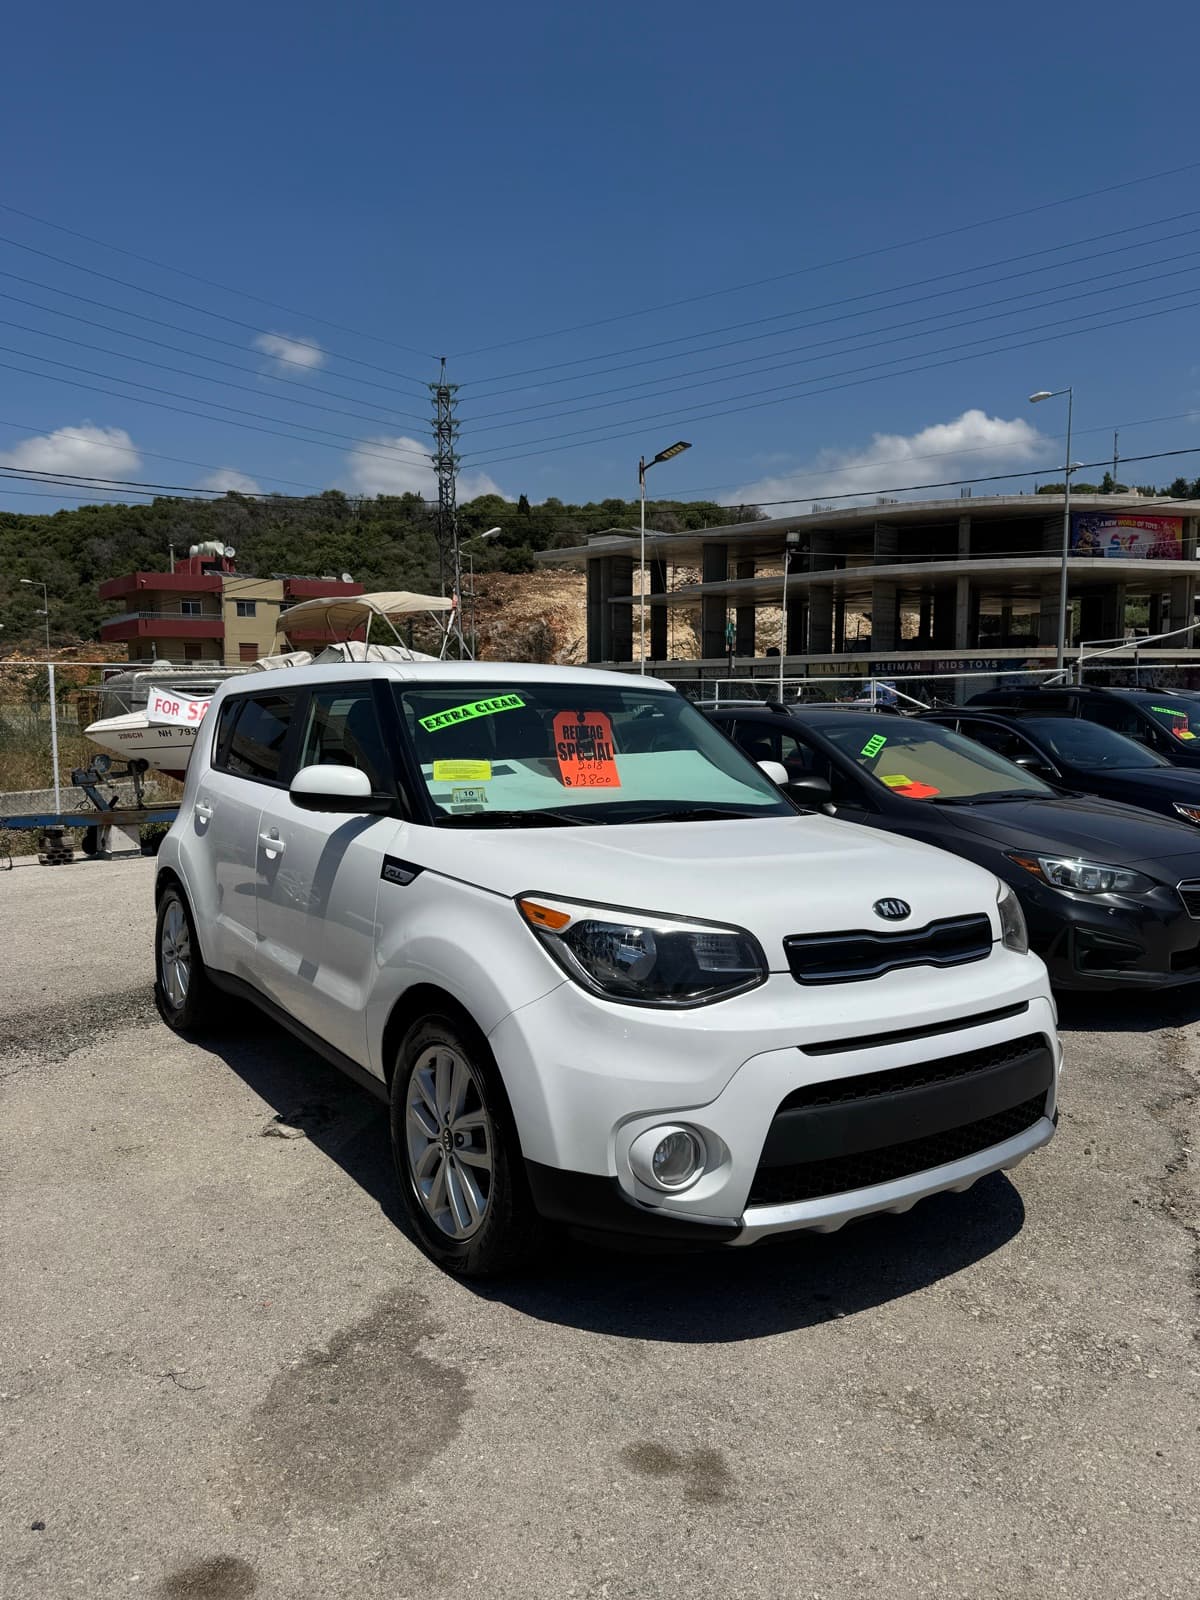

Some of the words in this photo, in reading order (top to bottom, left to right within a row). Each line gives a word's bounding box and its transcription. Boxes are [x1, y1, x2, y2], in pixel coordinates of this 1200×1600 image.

[1145, 521, 1158, 530] TOYS
[875, 662, 921, 671] SLEIMAN
[938, 661, 964, 669] KIDS
[968, 660, 998, 669] TOYS
[154, 698, 180, 716] FOR
[424, 708, 474, 729] EXTRA
[475, 696, 521, 713] CLEAN
[557, 742, 614, 760] SPEIAL
[864, 736, 884, 755] SALE
[578, 760, 602, 770] 2018
[565, 776, 572, 785] $
[878, 900, 909, 916] KIA
